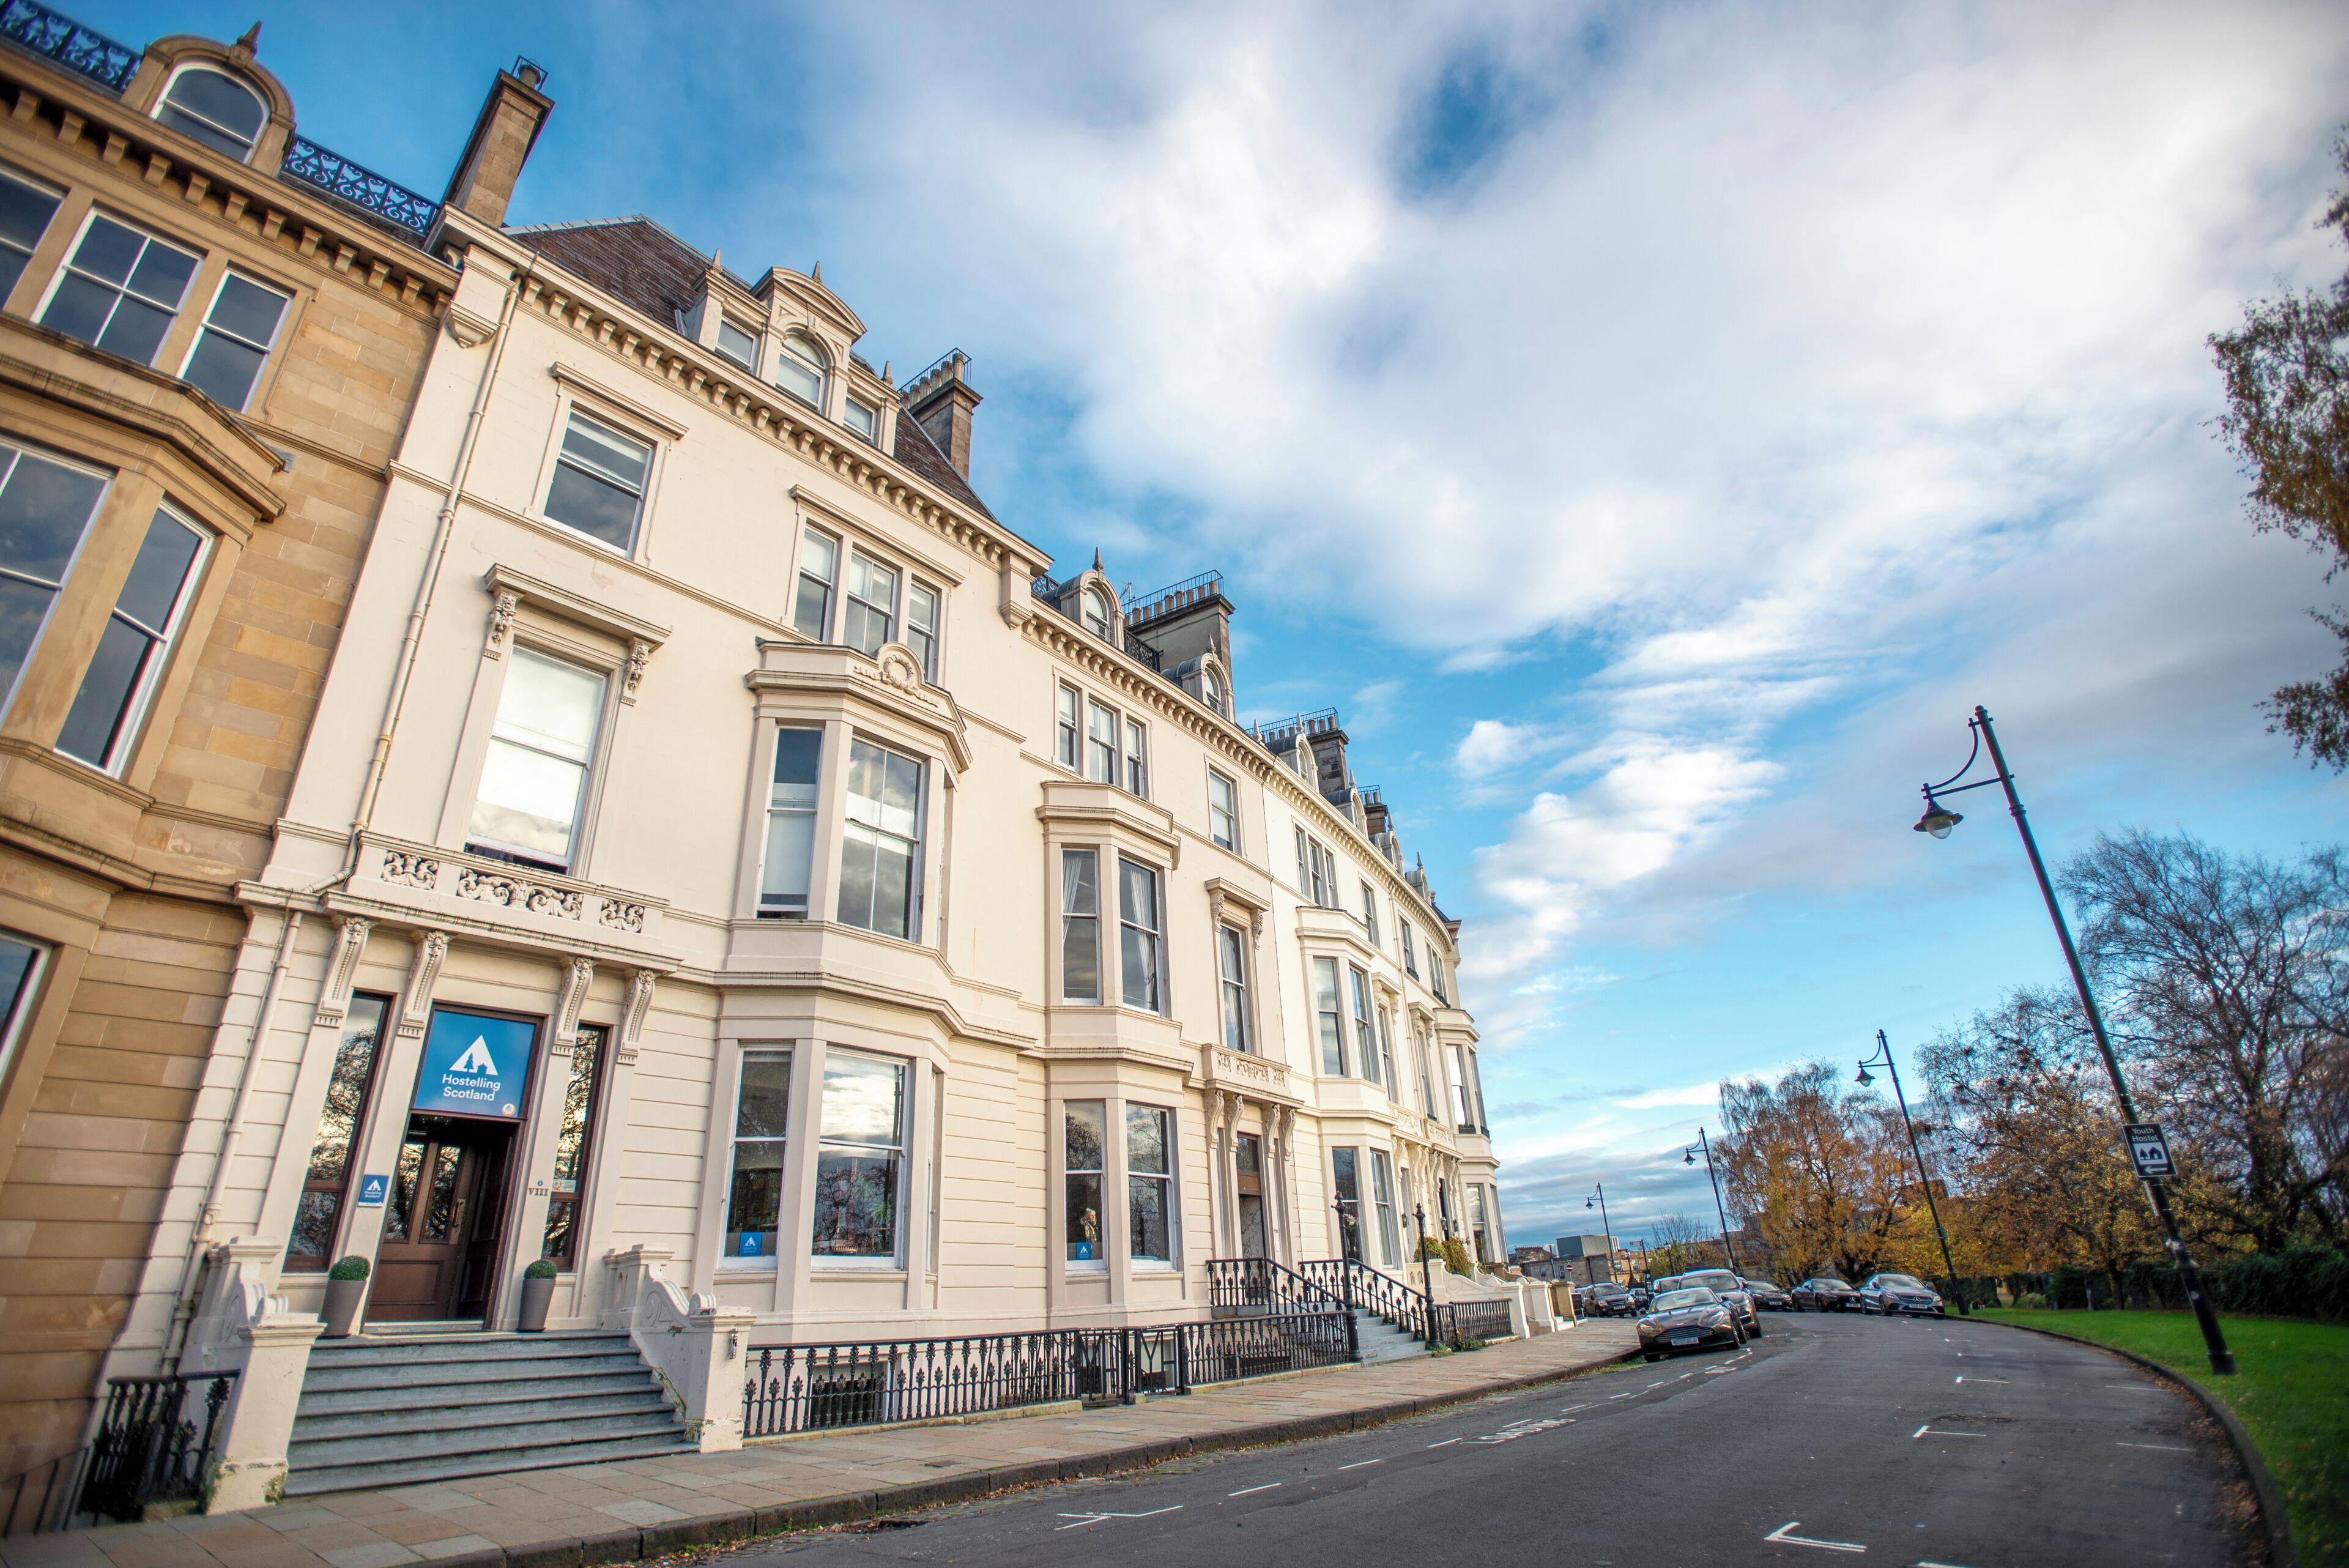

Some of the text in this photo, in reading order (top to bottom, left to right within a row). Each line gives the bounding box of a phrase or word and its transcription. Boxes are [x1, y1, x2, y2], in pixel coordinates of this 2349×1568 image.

[442, 1074, 501, 1091] Hostelling
[443, 1086, 495, 1101] Scotland
[528, 1187, 549, 1196] VIII
[1460, 1419, 1576, 1444] LOADING
